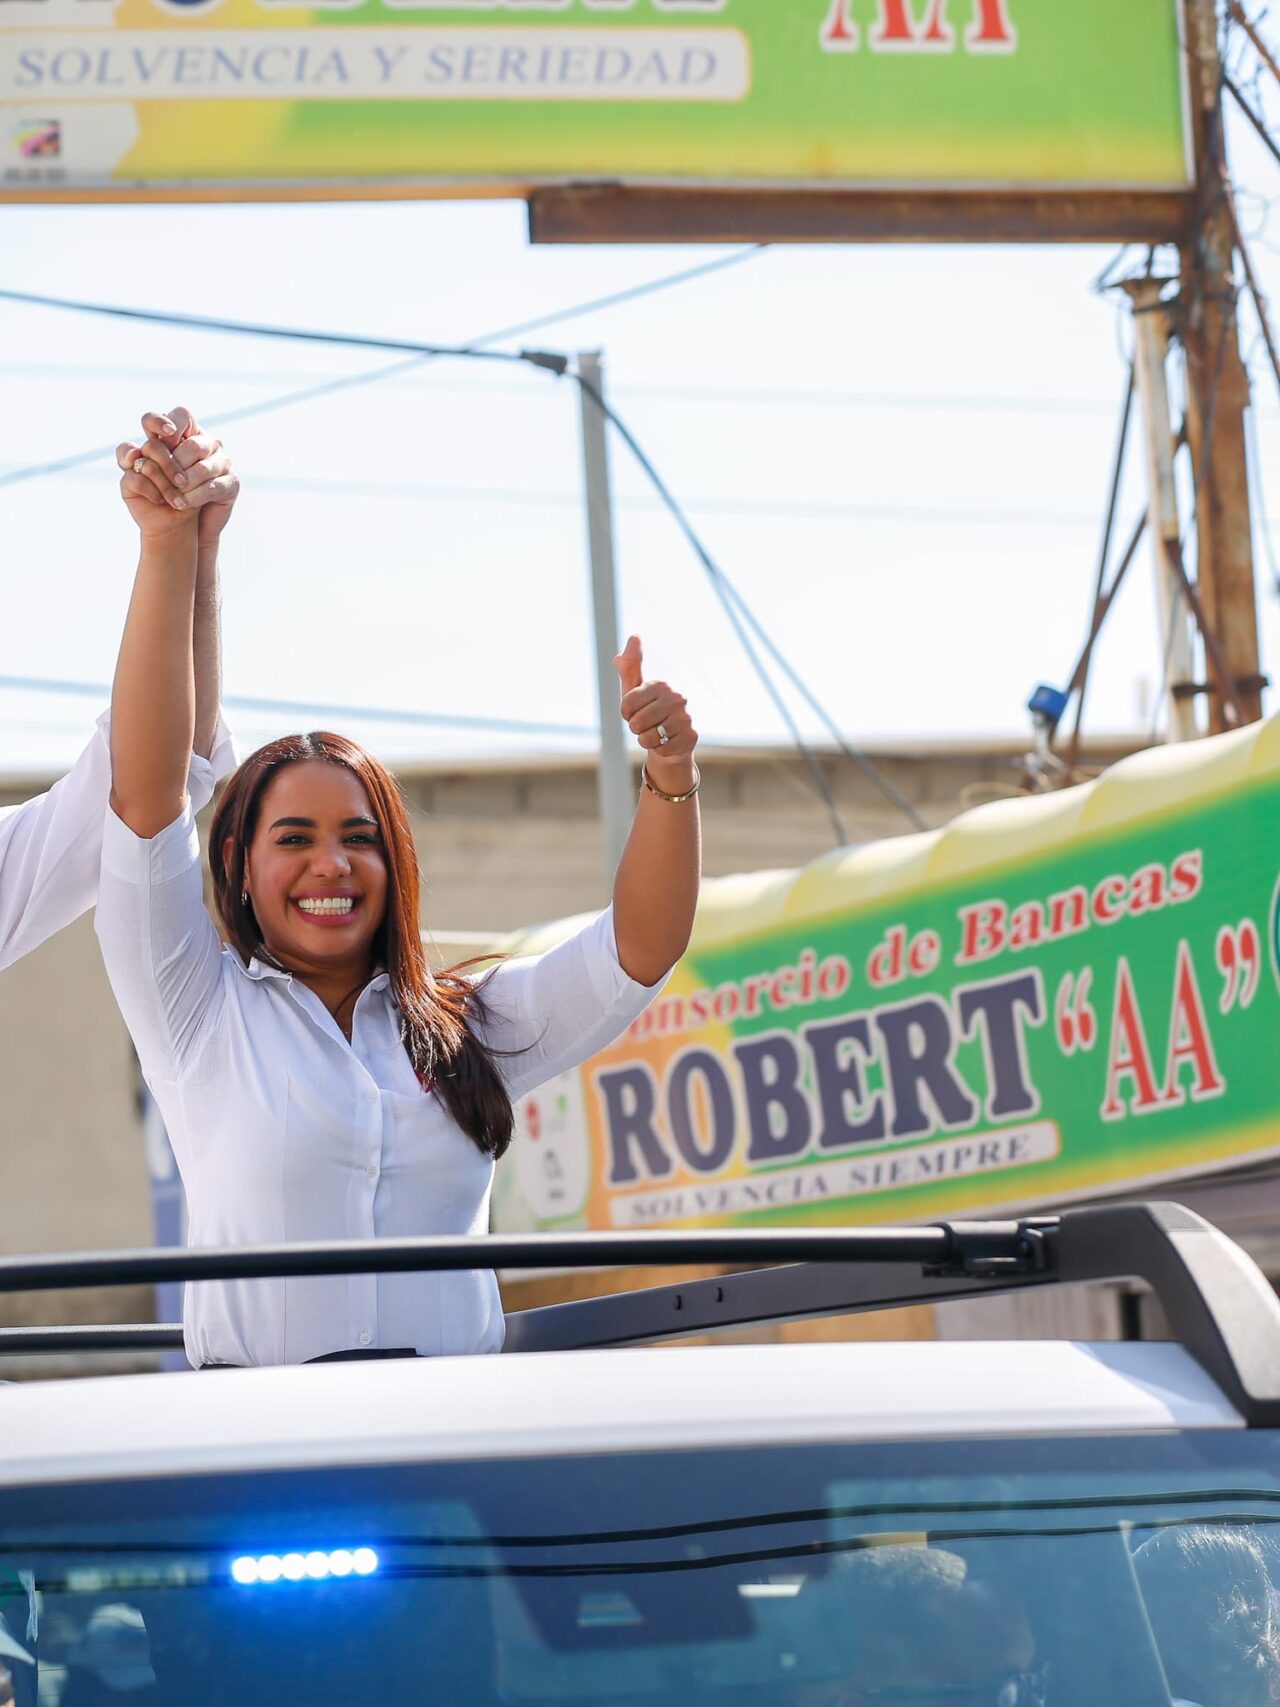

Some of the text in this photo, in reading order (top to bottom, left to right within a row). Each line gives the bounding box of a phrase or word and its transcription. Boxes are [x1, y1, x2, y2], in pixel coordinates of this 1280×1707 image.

[14, 44, 719, 87] SOLVENCIA Y SERIEDAD
[627, 850, 1203, 1039] onsorcio de Bancas
[597, 968, 1046, 1186] ROBERT
[632, 1132, 1032, 1221] SOLVENCIA SIEMPRE
